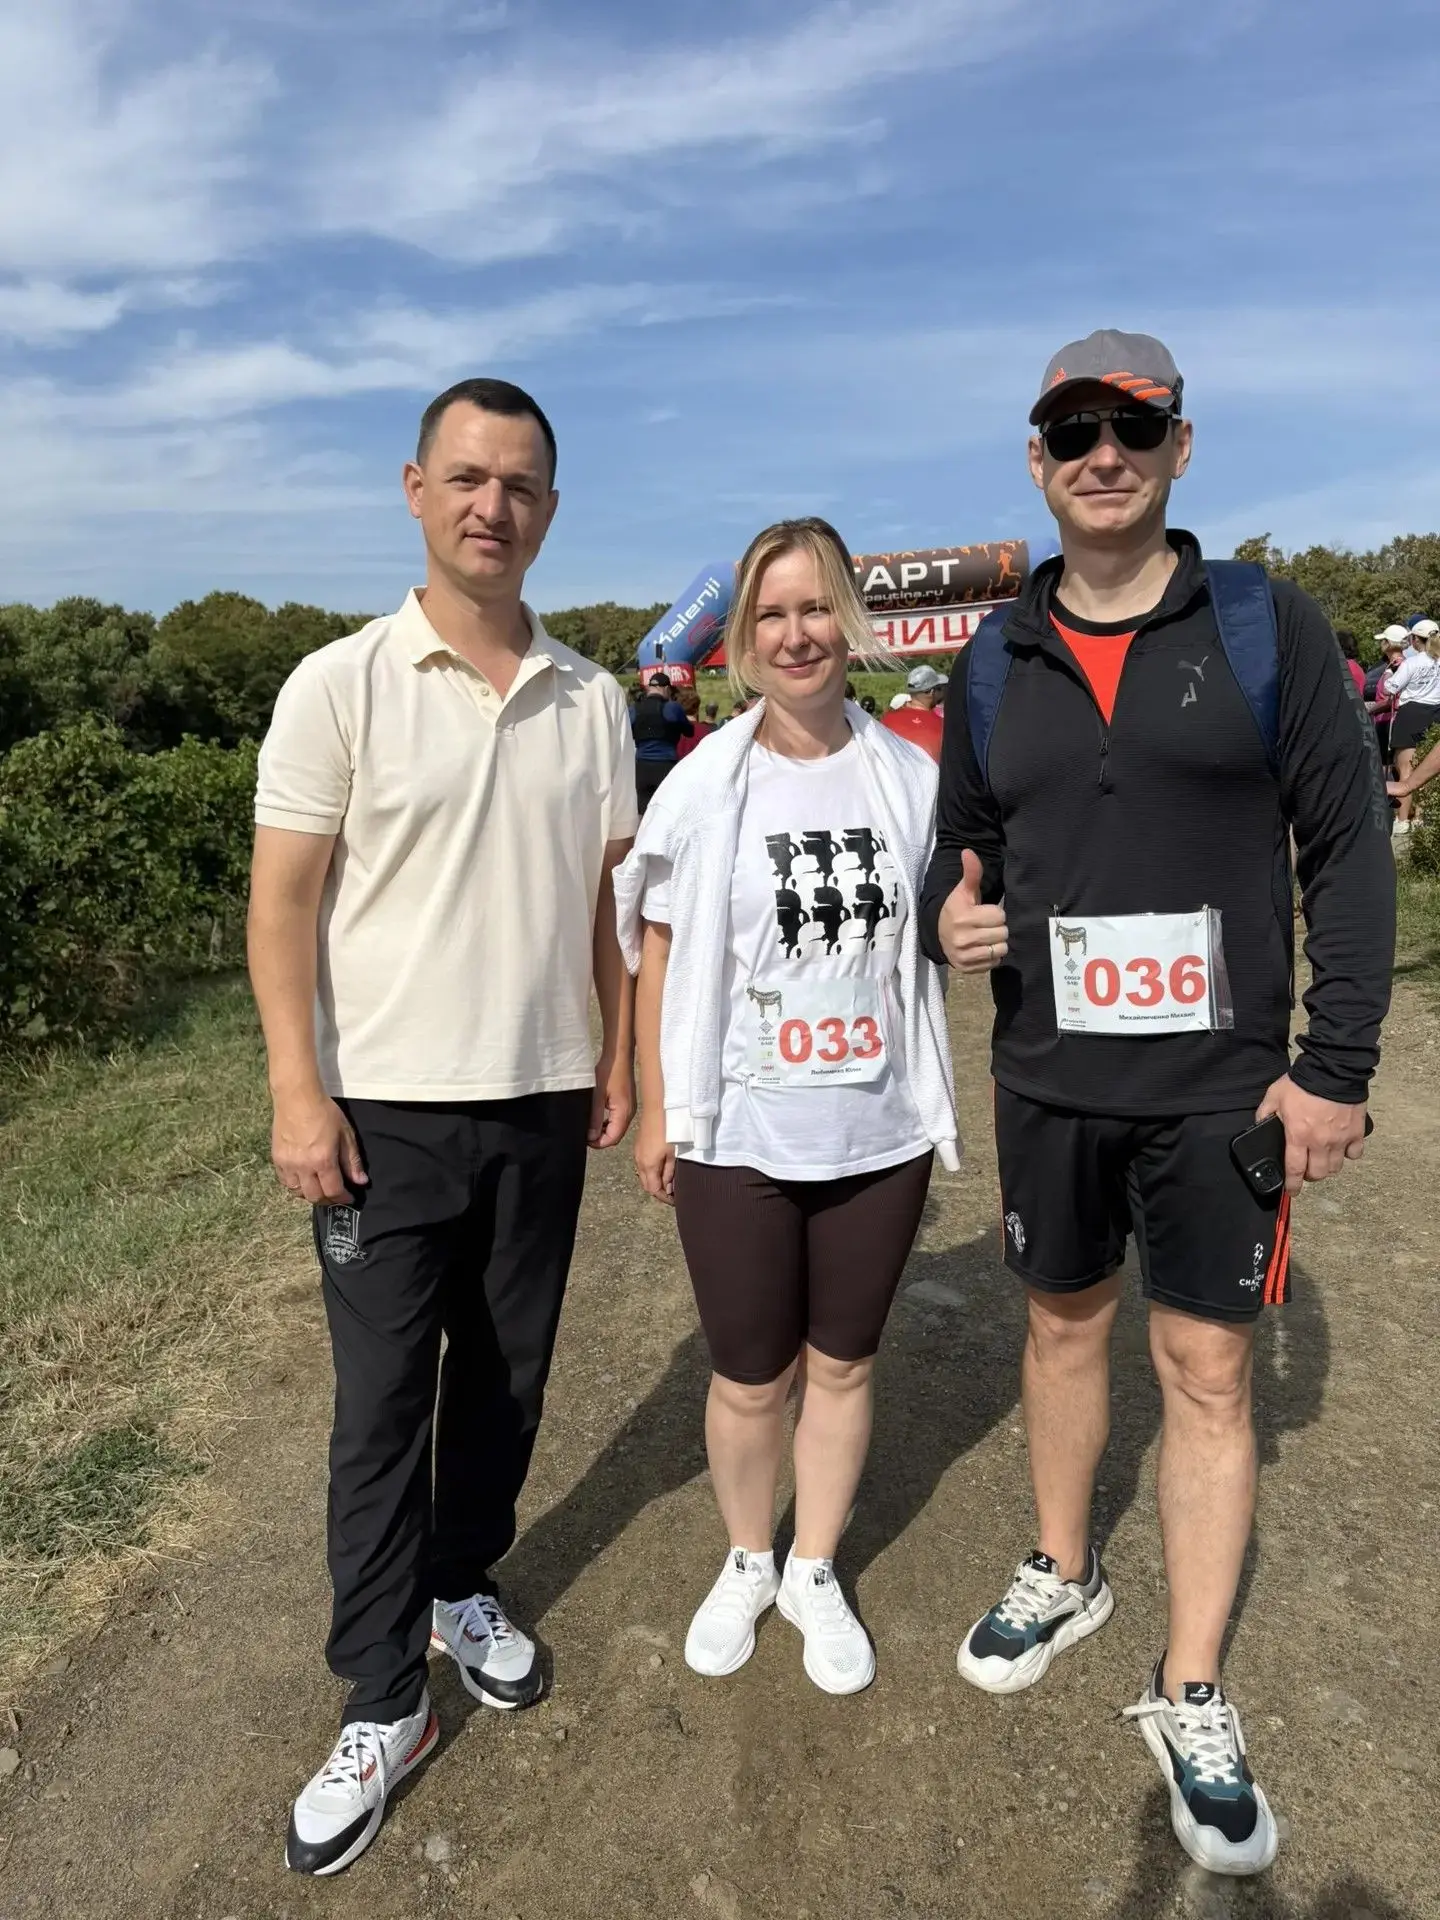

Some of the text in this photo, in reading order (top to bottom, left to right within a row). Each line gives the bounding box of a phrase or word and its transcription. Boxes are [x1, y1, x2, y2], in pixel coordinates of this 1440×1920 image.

[854, 558, 960, 592] АРТ
[1083, 954, 1207, 1007] 036
[779, 1016, 884, 1064] 033
